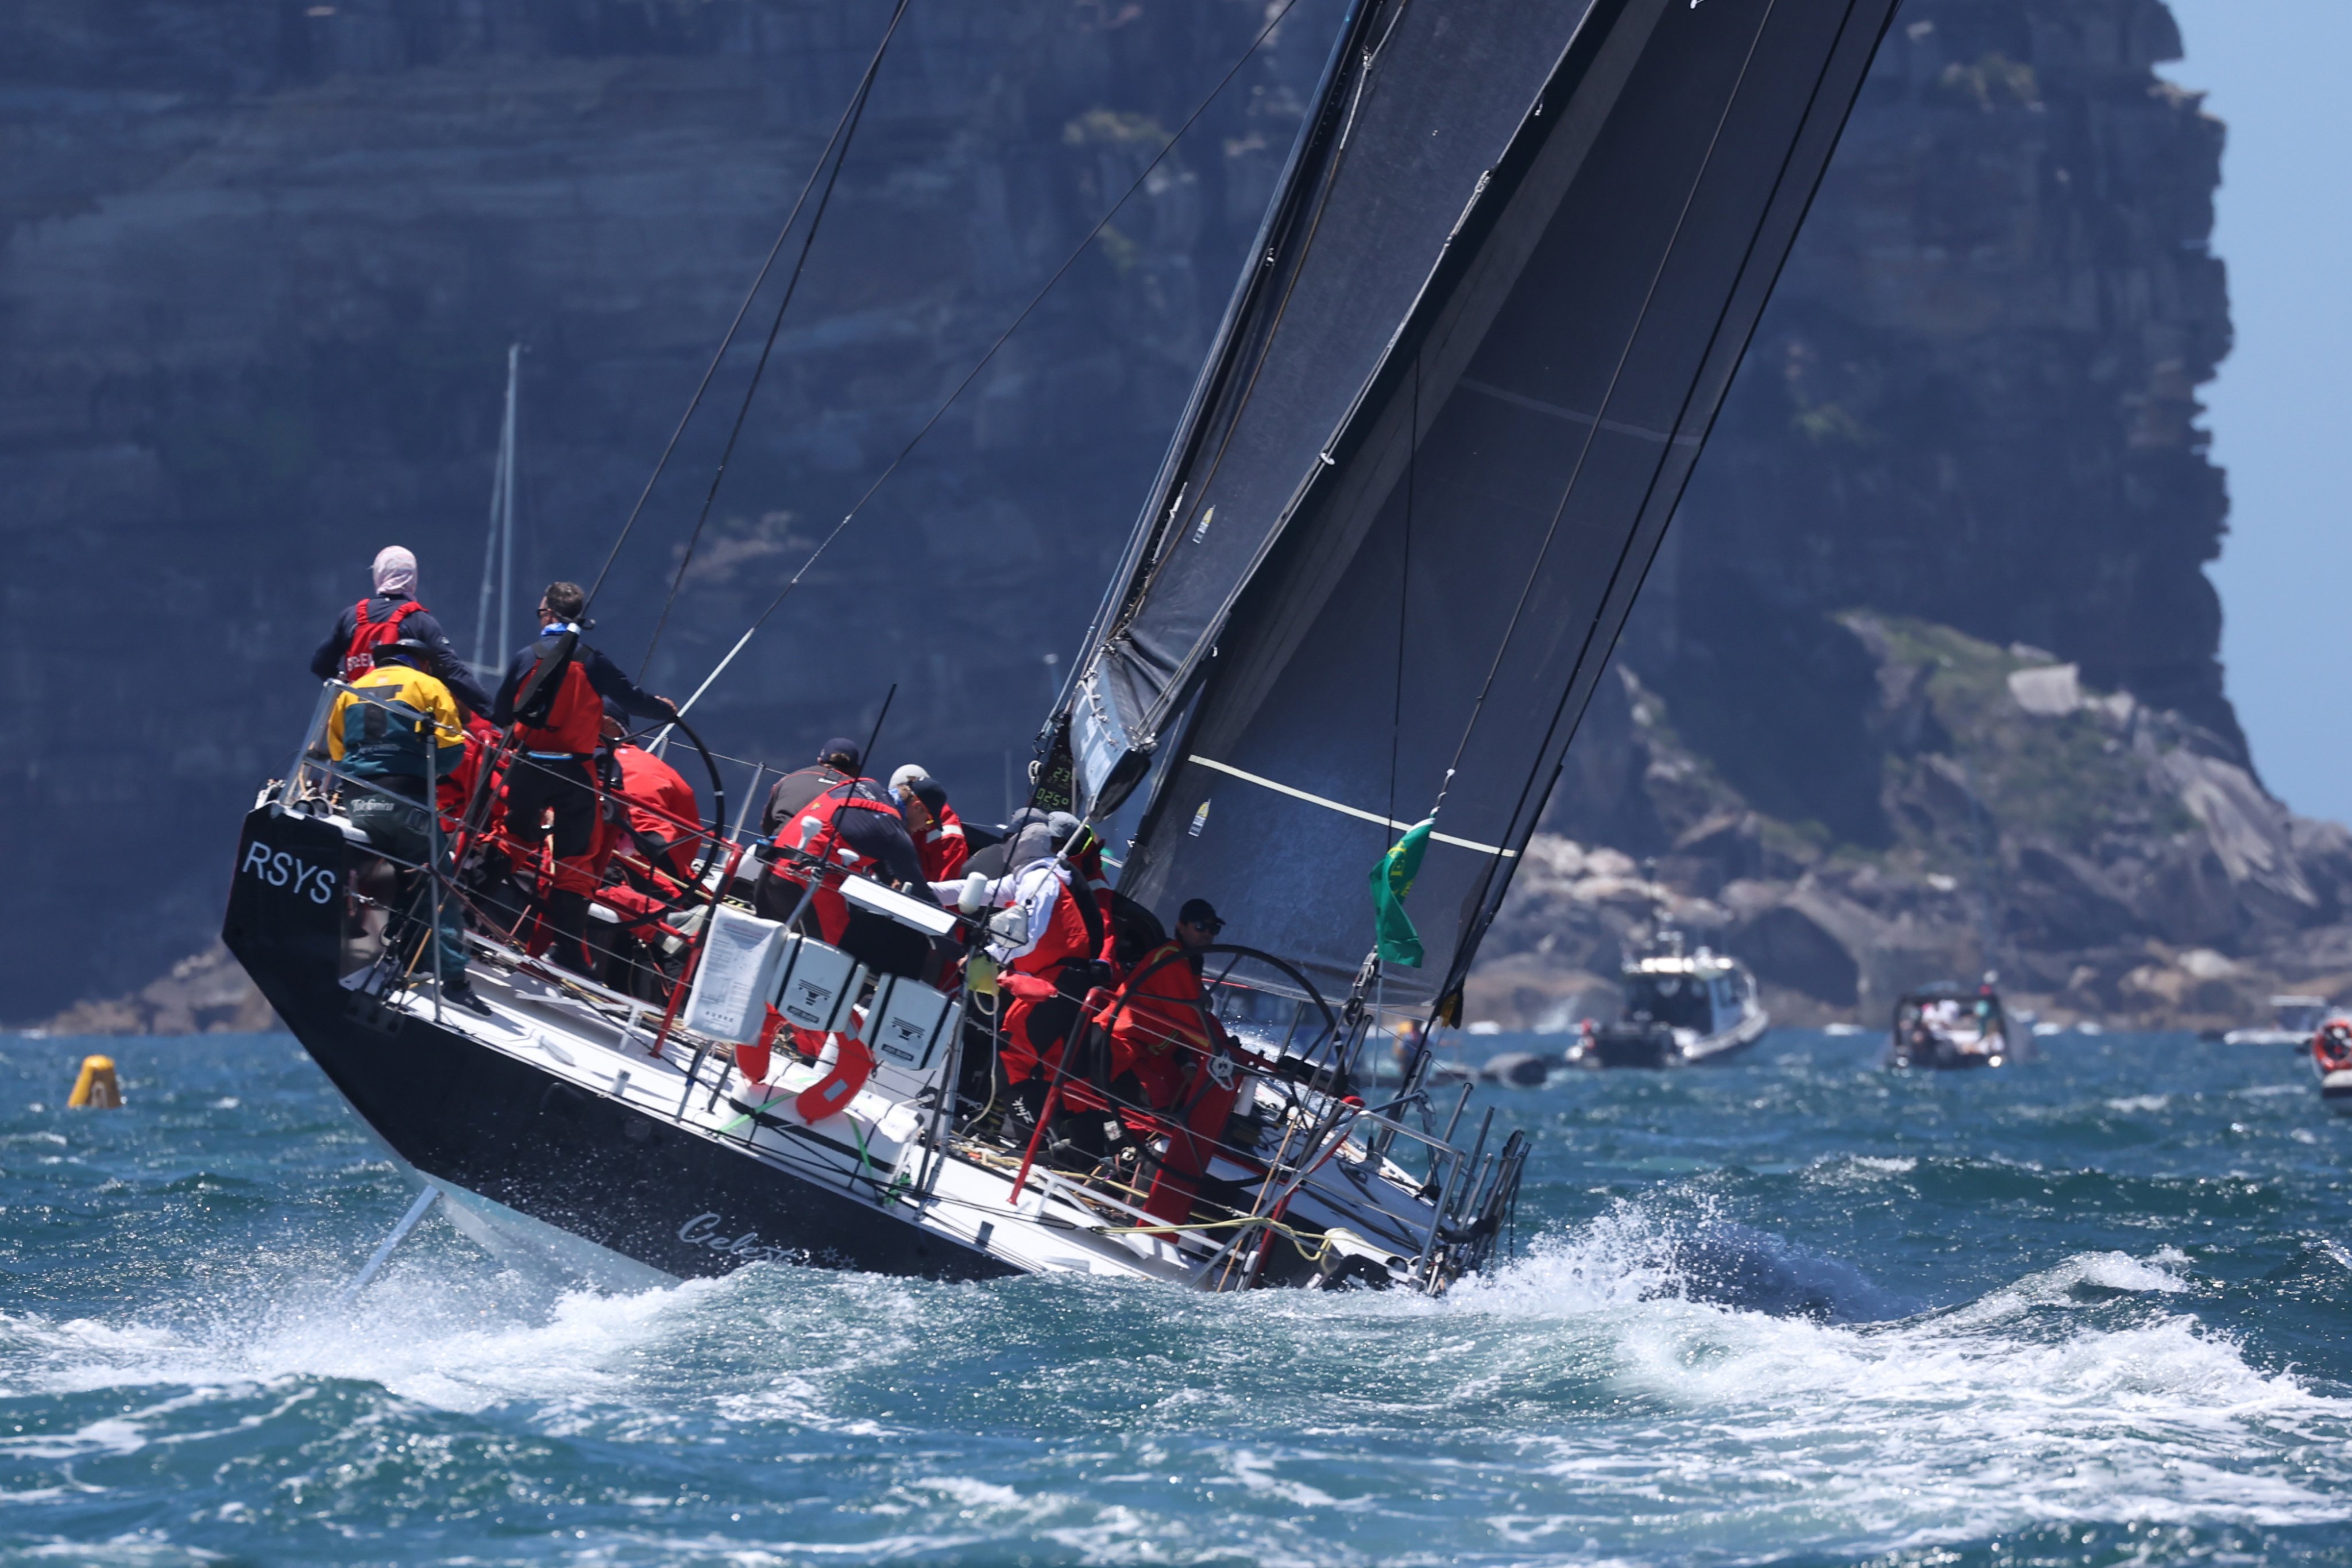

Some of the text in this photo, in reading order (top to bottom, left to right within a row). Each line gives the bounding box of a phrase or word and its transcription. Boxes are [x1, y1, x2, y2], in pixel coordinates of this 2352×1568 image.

[242, 841, 336, 904] RSYS
[1011, 1096, 1035, 1124] Zhik
[679, 1212, 811, 1264] Celest
